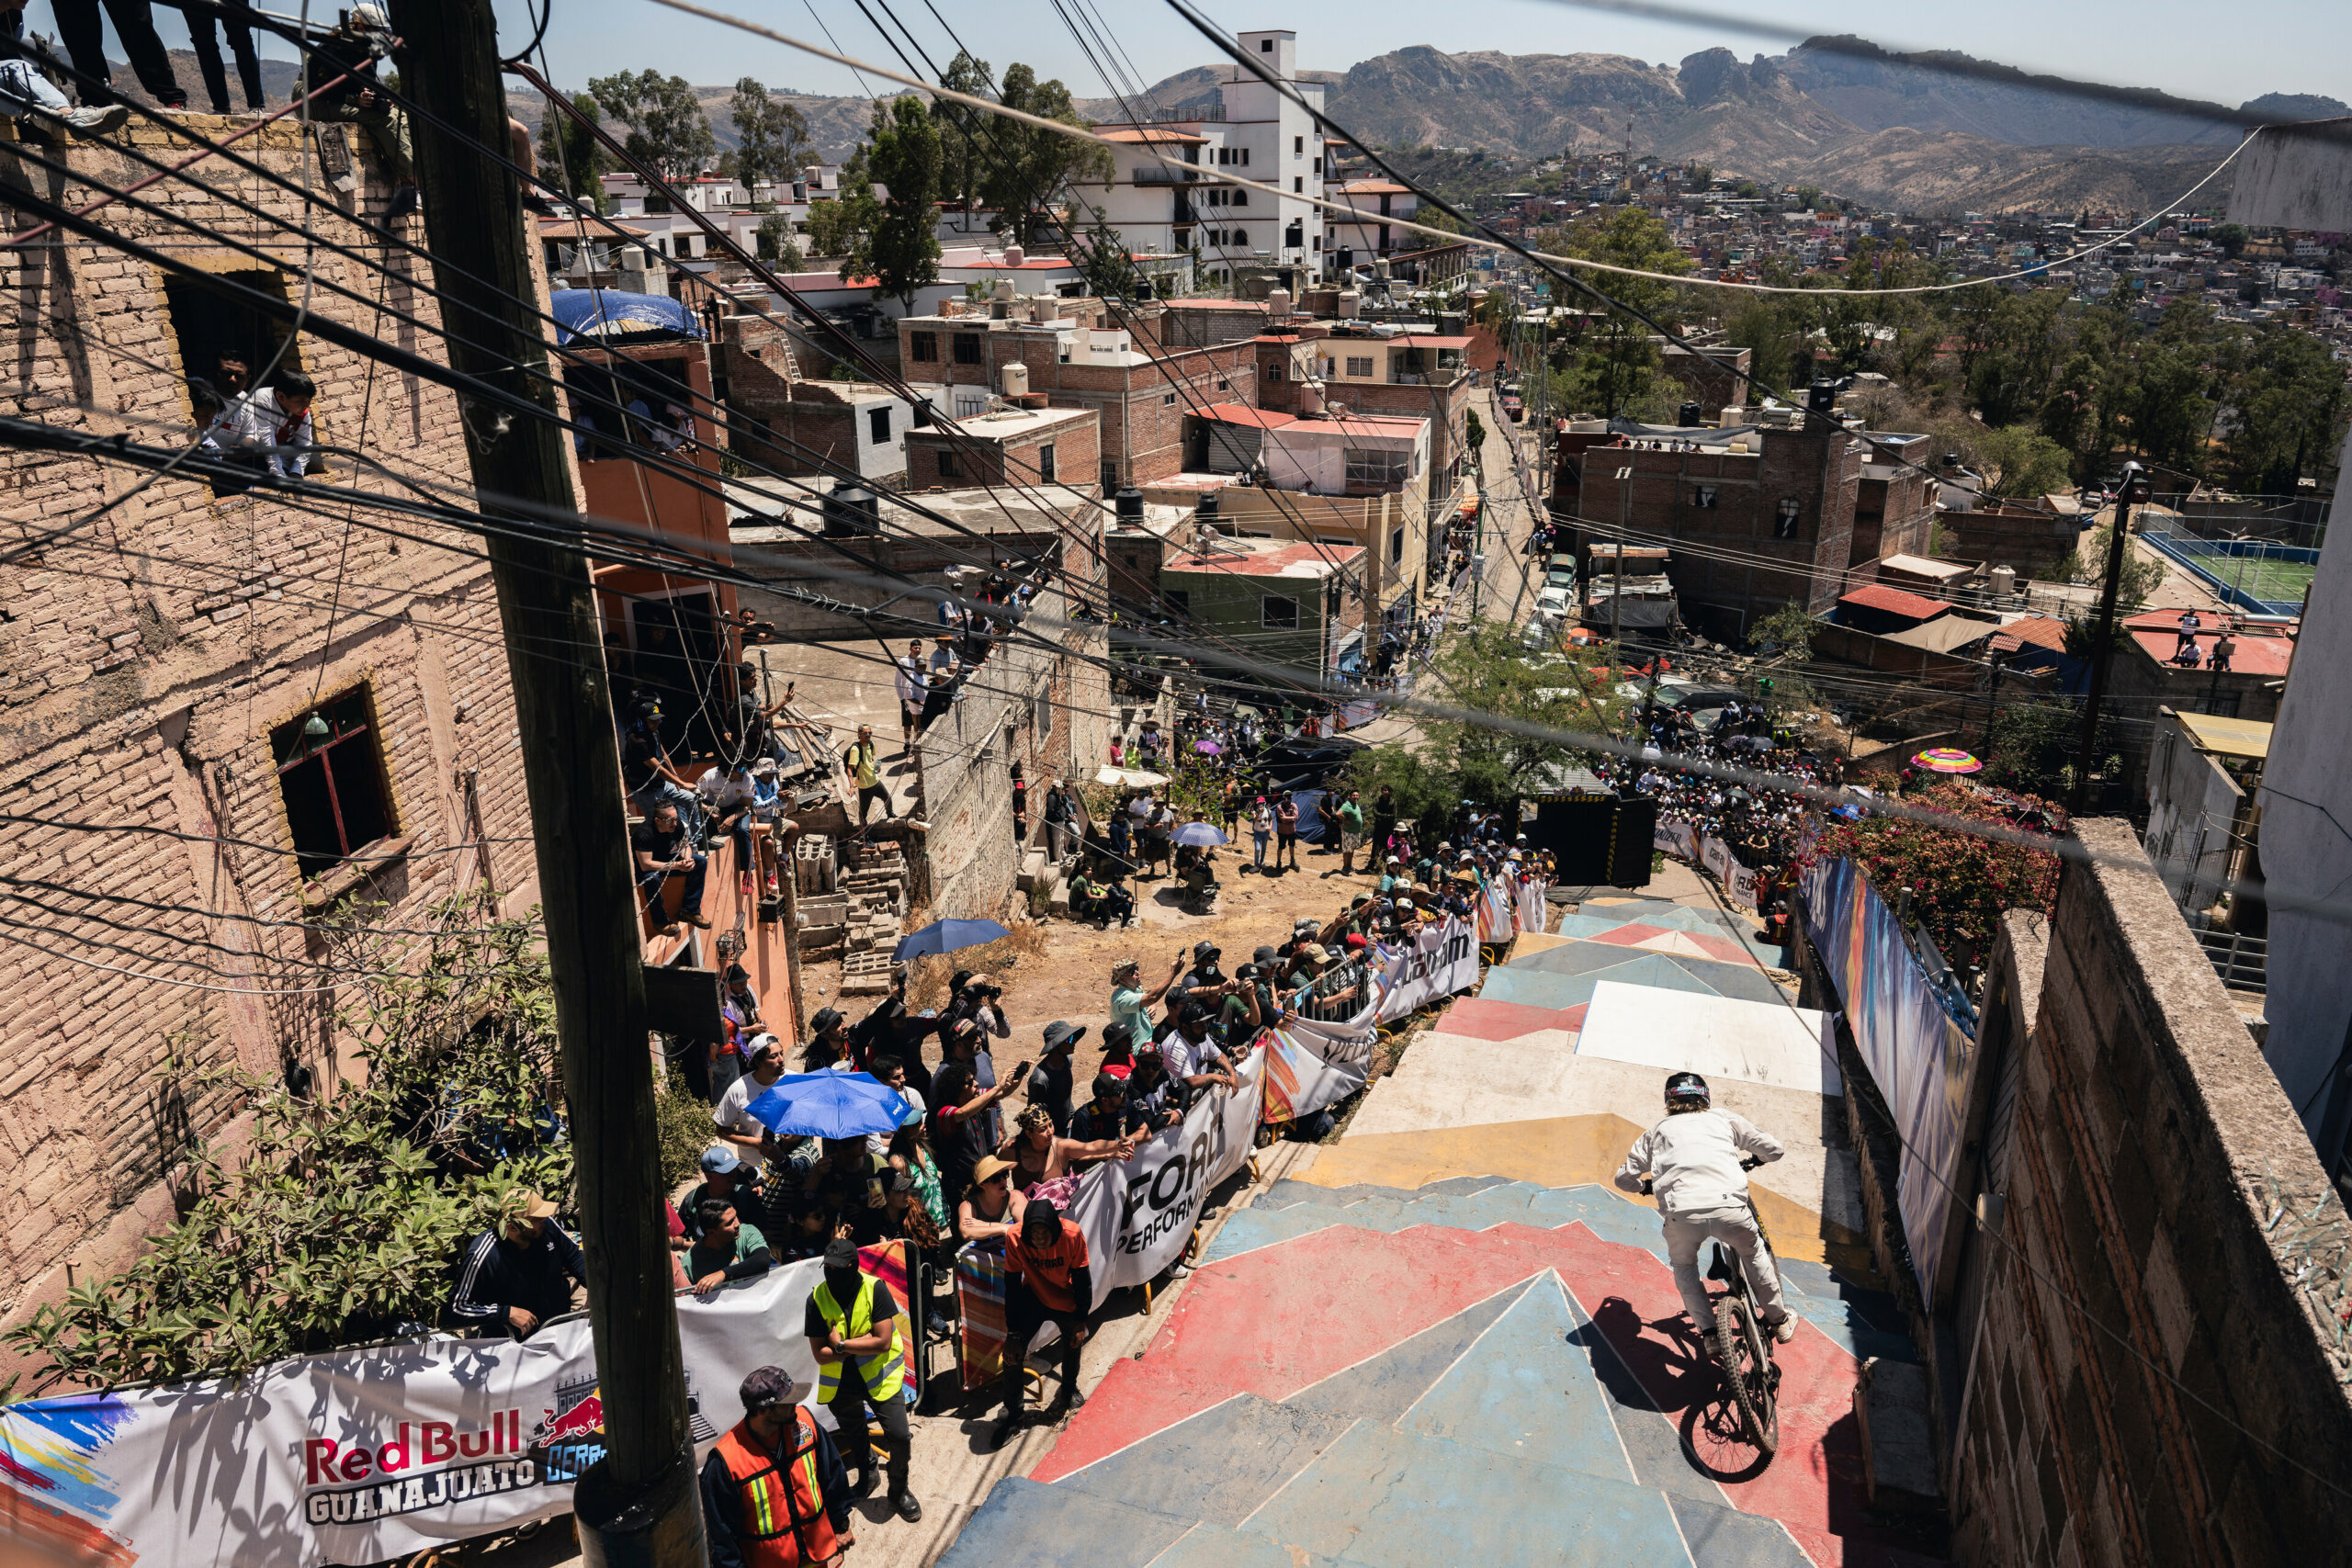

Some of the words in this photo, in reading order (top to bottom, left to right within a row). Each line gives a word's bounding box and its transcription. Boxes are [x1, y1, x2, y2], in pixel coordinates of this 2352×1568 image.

[1655, 828, 1682, 843] IALIZED
[1735, 874, 1756, 892] ORD
[306, 1421, 411, 1484] Red
[422, 1408, 519, 1465] Bull
[547, 1443, 607, 1482] CERR
[309, 1459, 535, 1523] GUANAJUATO
